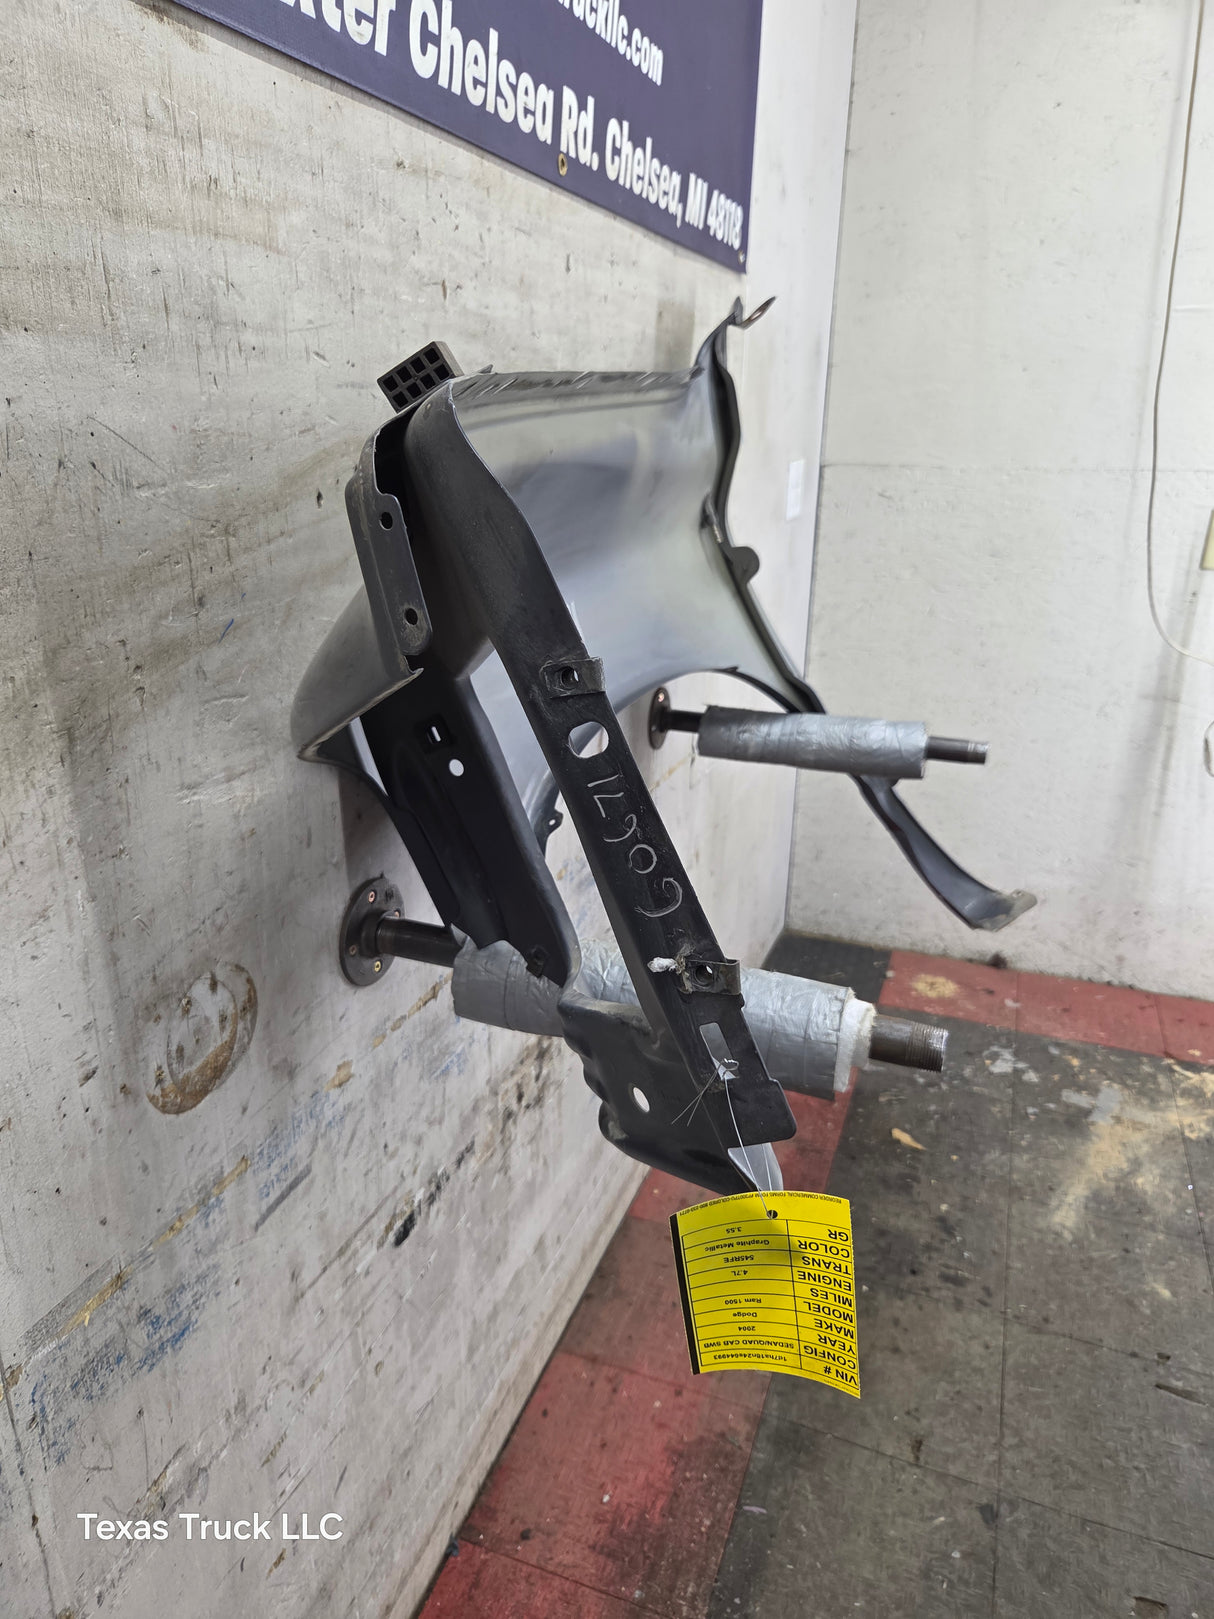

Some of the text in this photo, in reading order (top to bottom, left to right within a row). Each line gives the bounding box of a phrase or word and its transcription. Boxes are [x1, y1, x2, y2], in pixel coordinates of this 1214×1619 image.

[409, 0, 554, 145] Chelsea
[560, 85, 599, 171] Rd.
[605, 118, 683, 229] Chelsea,
[685, 173, 708, 230] MI
[706, 189, 744, 250] 48118
[788, 1192, 819, 1200] COMMERCIAL
[726, 1226, 742, 1234] 3.55
[827, 1229, 849, 1242] GR
[705, 1242, 734, 1252] Metallic
[797, 1239, 850, 1258] COLOR
[723, 1254, 754, 1263] 545RFE
[802, 1255, 851, 1276] TRANS
[797, 1270, 852, 1292] ENGINE
[810, 1287, 852, 1308] MILES
[803, 1300, 853, 1323] MODEL
[814, 1318, 854, 1339] MAKE
[742, 1339, 794, 1349] SEDAN/QUAD
[817, 1333, 855, 1355] YEAR
[803, 1345, 856, 1370] CONFIG
[823, 1365, 832, 1375] #
[836, 1369, 858, 1386] VIN
